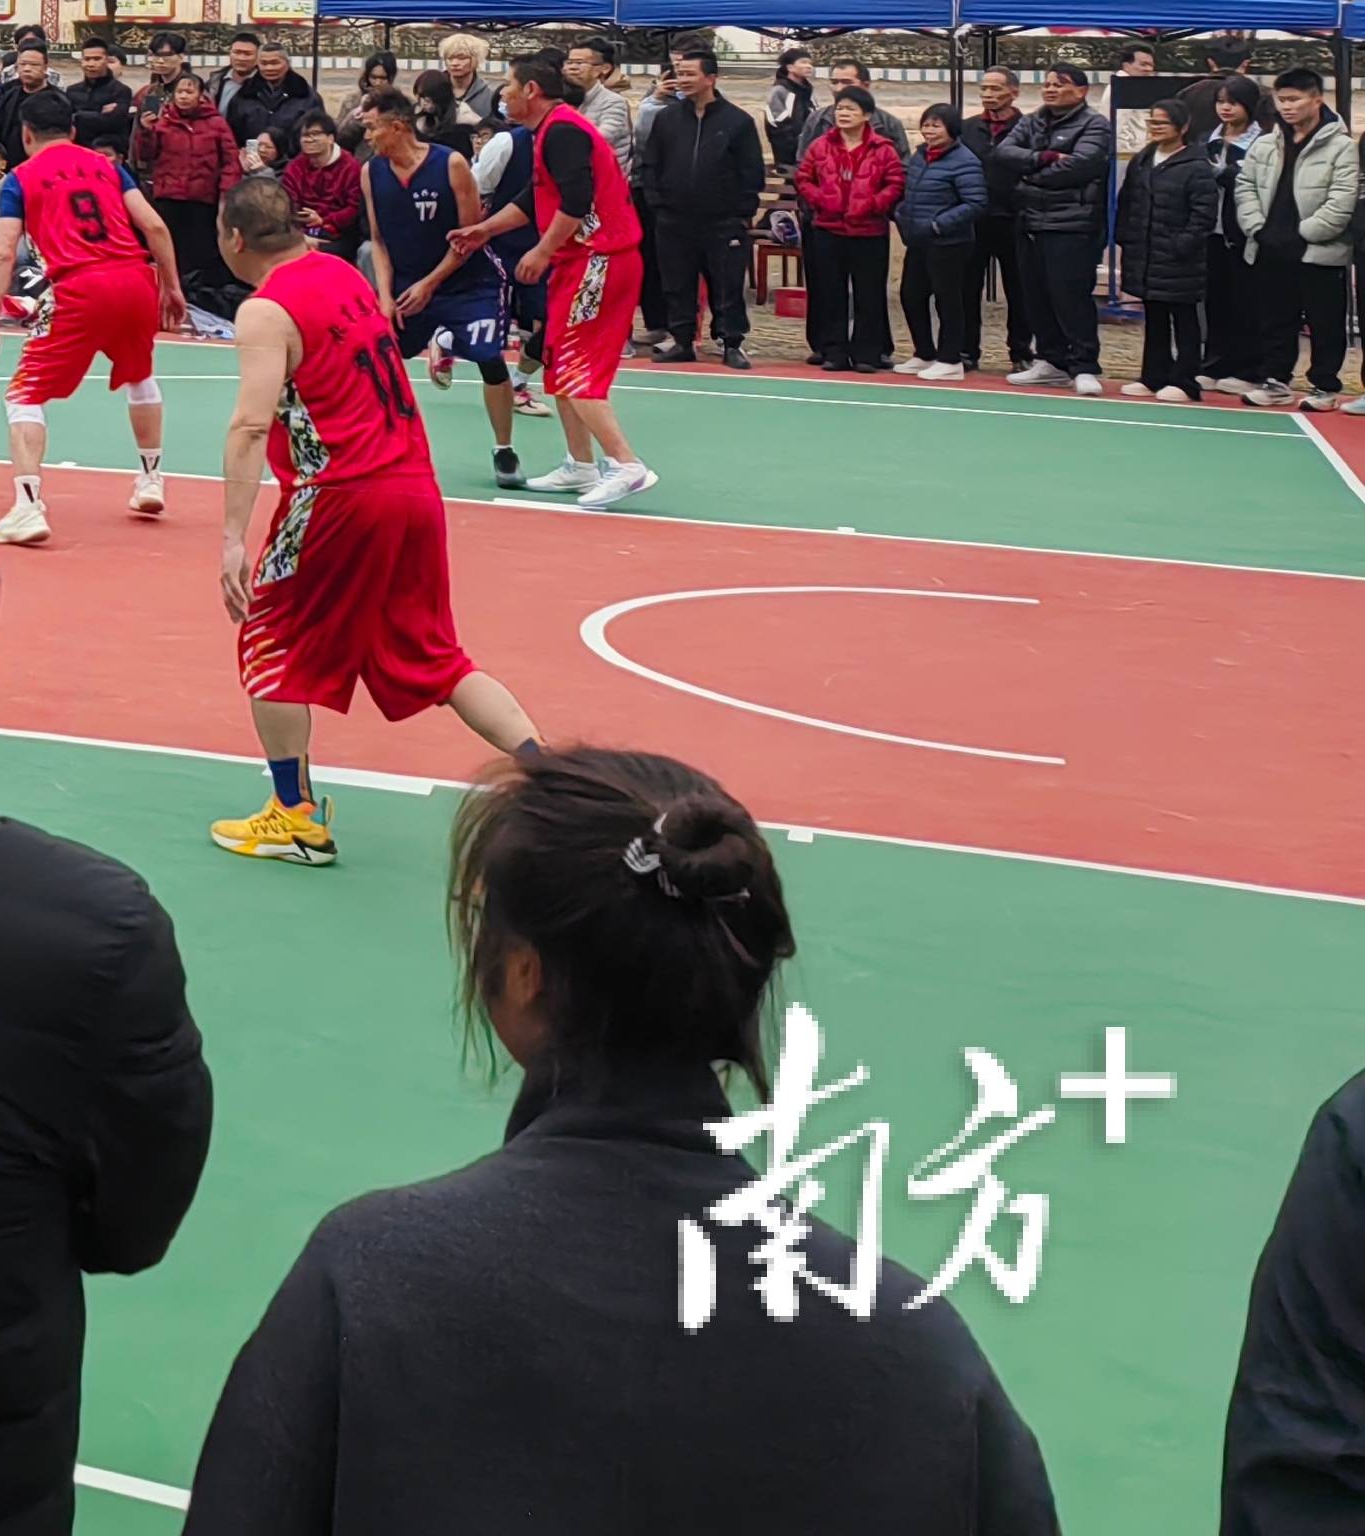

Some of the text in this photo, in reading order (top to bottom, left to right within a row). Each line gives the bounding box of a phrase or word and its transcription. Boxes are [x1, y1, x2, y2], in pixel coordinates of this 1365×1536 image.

[70, 191, 109, 242] 9
[415, 201, 438, 221] 77
[466, 319, 495, 345] 77
